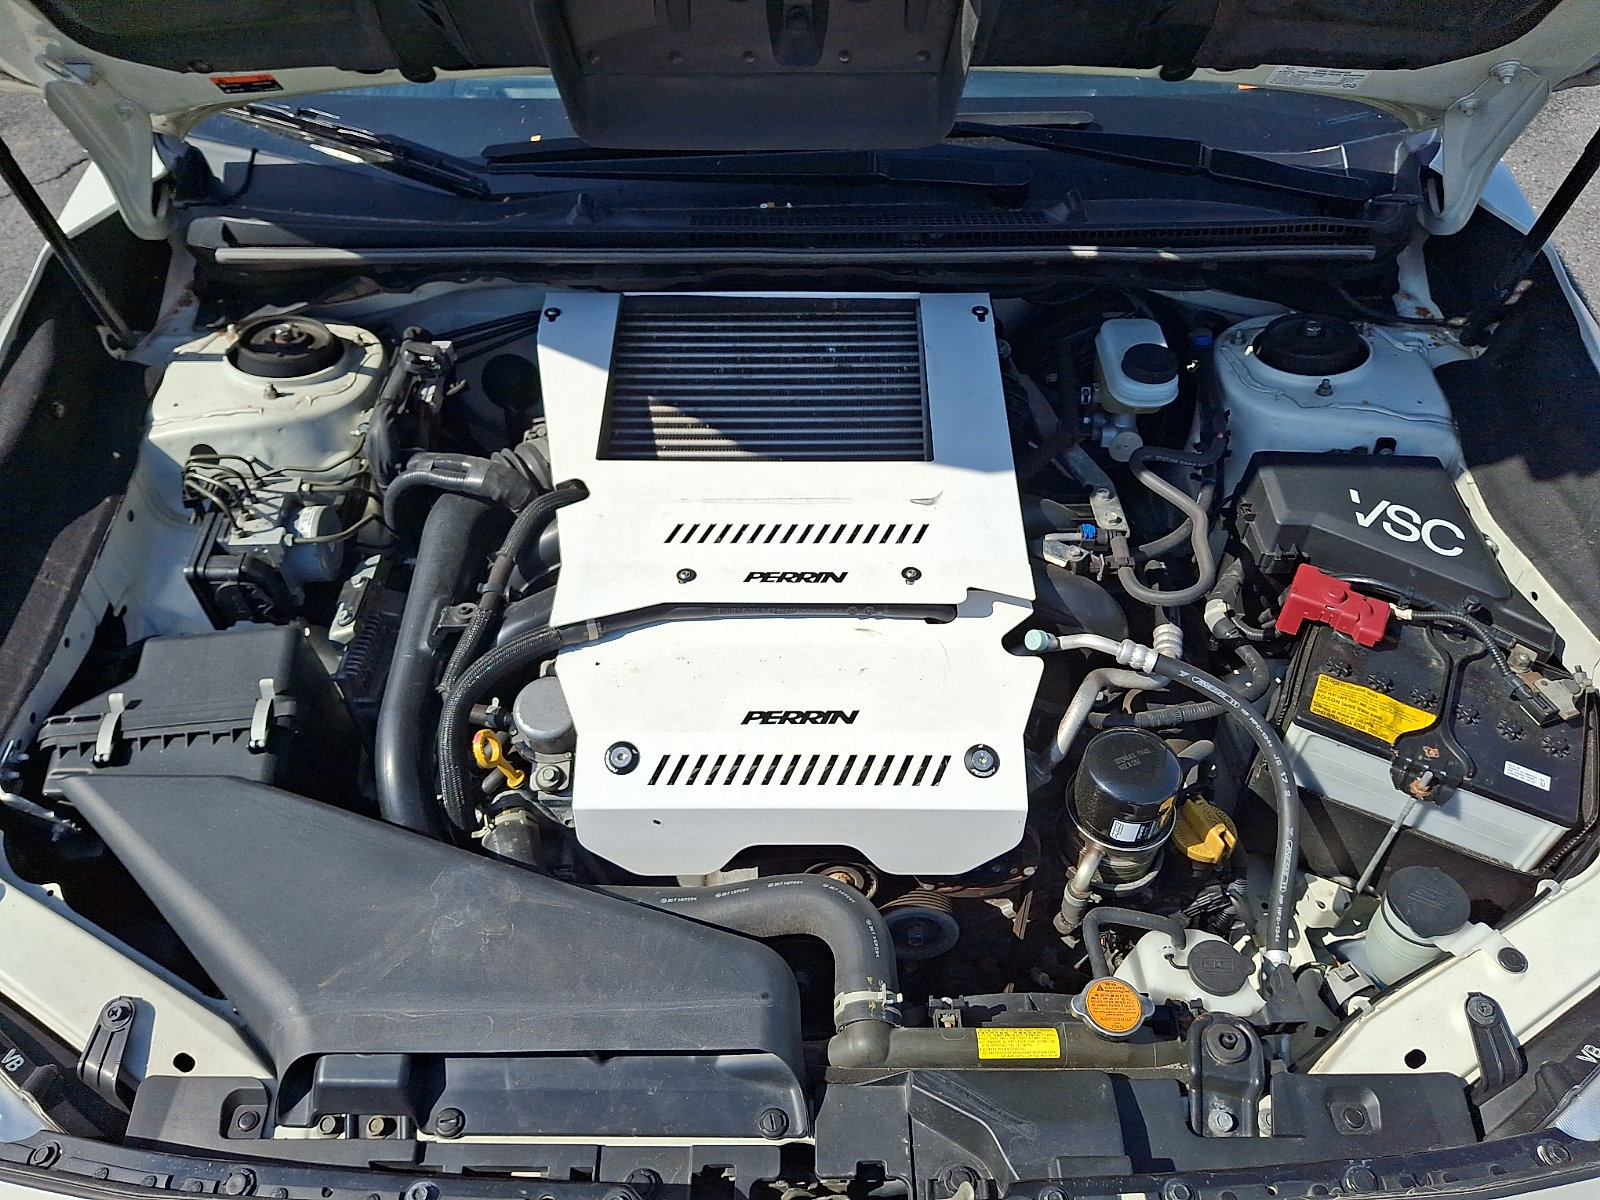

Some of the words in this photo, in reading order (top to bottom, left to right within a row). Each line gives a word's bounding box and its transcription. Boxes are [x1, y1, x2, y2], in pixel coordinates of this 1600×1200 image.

[1349, 488, 1465, 556] VSC
[743, 572, 848, 583] PERRIN
[1315, 692, 1340, 704] POISON
[740, 710, 860, 724] PERRIN
[1281, 771, 1289, 784] 17
